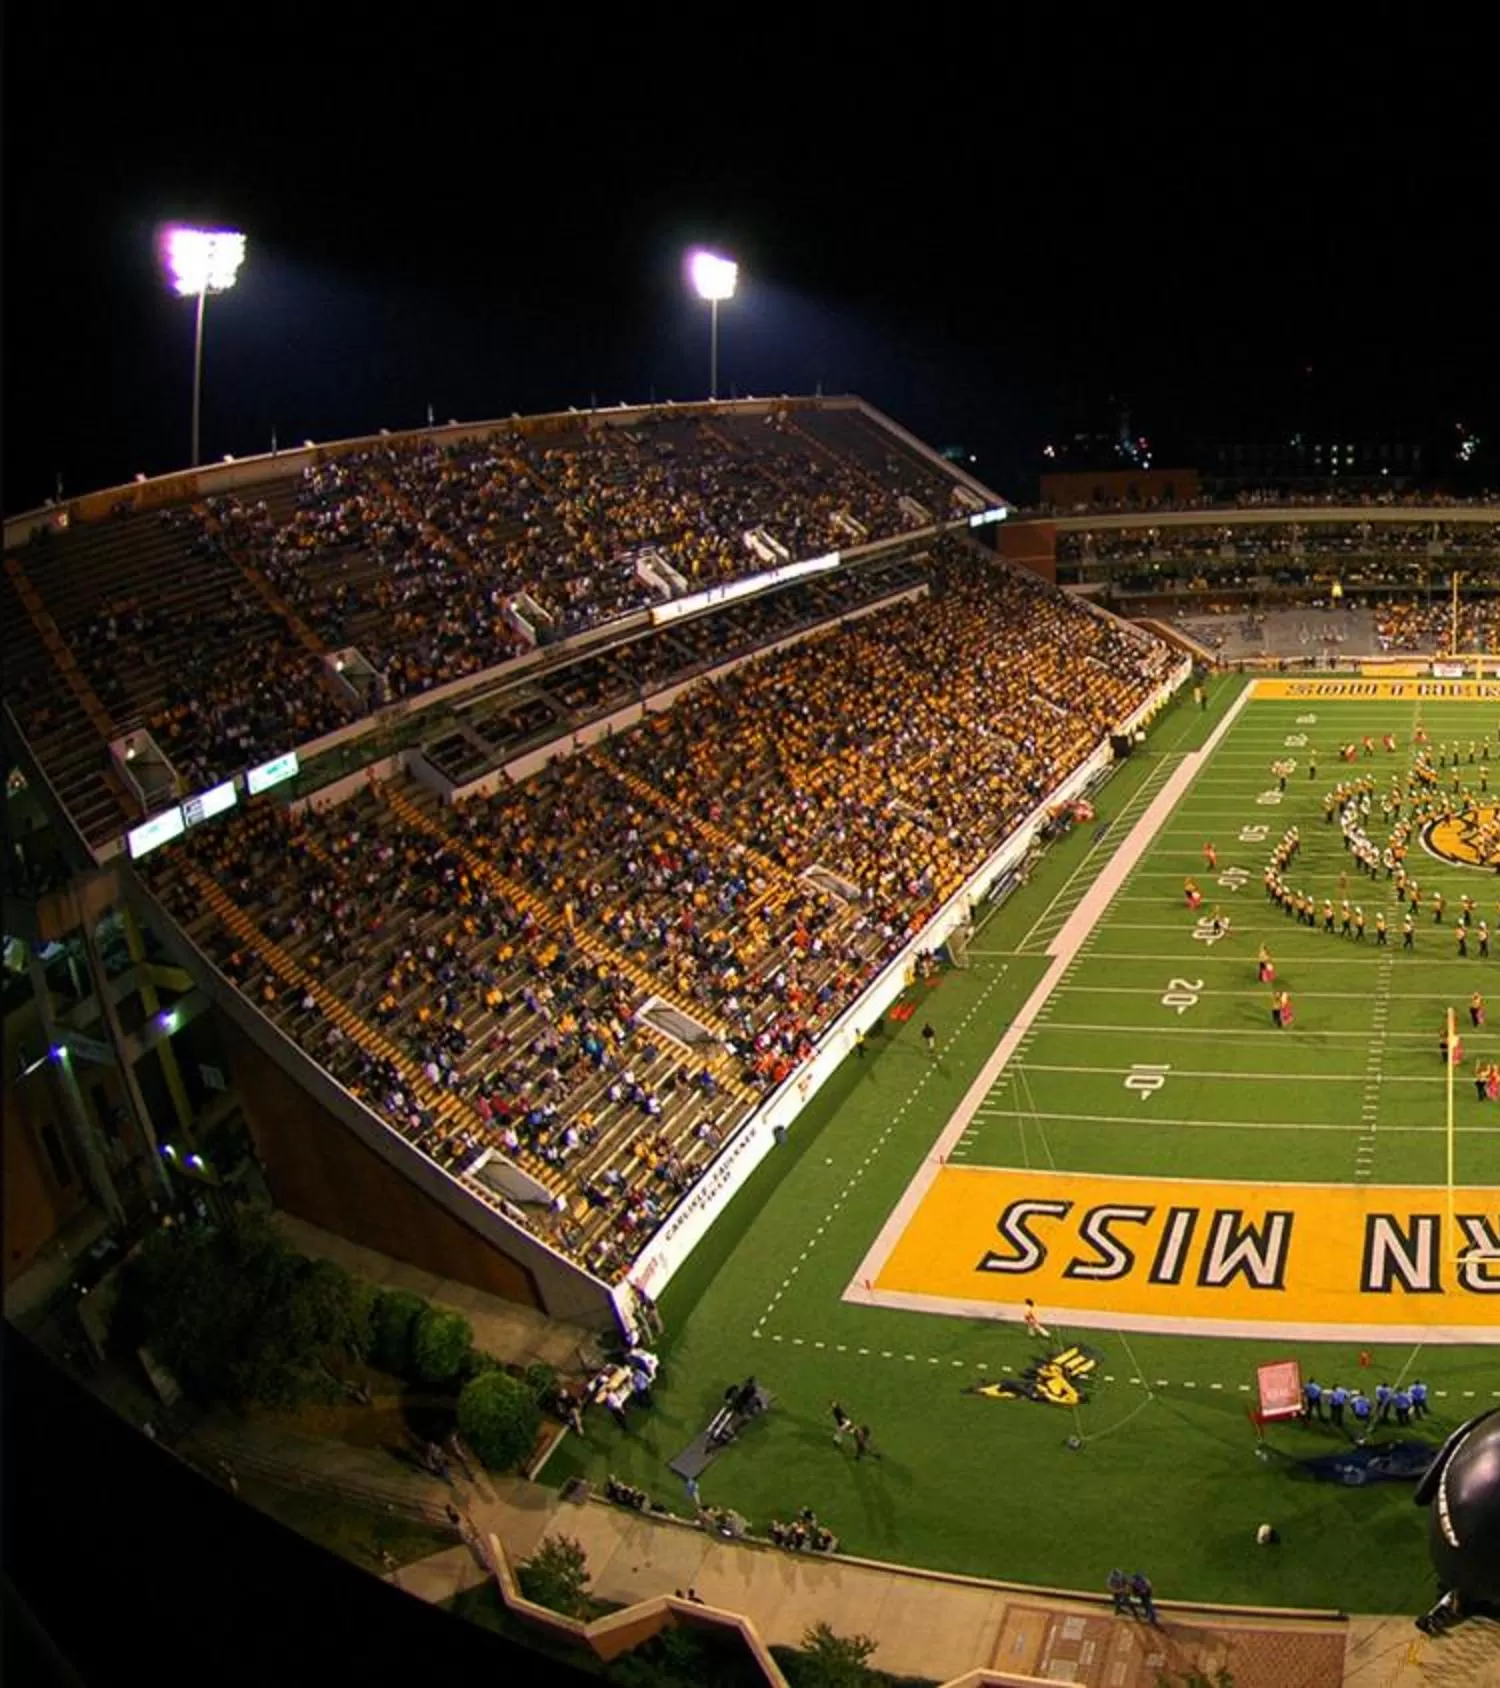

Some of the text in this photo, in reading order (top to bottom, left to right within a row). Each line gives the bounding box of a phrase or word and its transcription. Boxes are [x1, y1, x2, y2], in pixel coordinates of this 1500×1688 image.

[1238, 825, 1269, 842] 50
[1161, 977, 1204, 1006] 20
[1124, 1062, 1172, 1090] 10
[975, 1198, 1295, 1291] MISS
